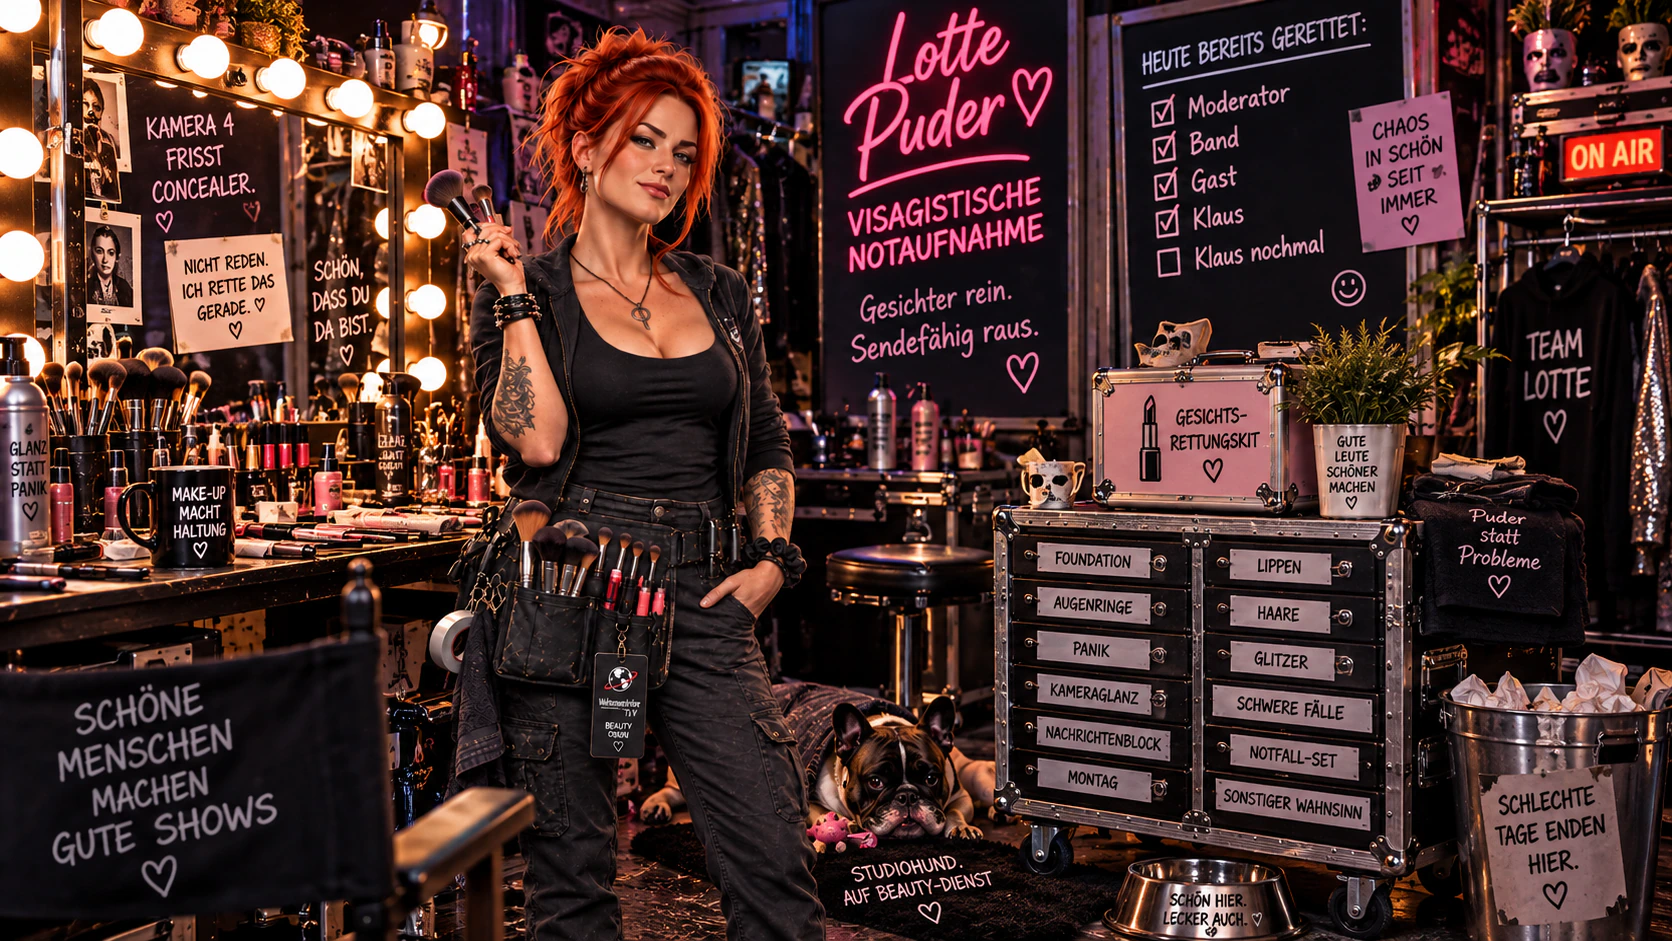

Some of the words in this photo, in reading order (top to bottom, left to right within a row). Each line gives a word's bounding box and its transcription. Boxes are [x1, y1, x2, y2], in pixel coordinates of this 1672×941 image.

[884, 8, 1010, 85] Lotte
[1142, 45, 1191, 75] HEUTE
[1198, 31, 1264, 64] BEREITS
[1272, 12, 1367, 50] GERETTET:
[1189, 85, 1290, 119] Moderator
[147, 114, 216, 140] KAMERA
[224, 112, 234, 135] 4
[844, 77, 1005, 182] Puder
[1373, 113, 1429, 140] CHAOS
[1190, 125, 1239, 155] Band
[1366, 148, 1381, 168] IN
[1389, 135, 1442, 162] SCHÖN
[166, 144, 224, 170] FRISST
[1572, 143, 1604, 170] ON
[1612, 138, 1653, 166] AIR
[152, 173, 255, 203] CONCEALER.
[1192, 166, 1237, 193] Gast
[1388, 165, 1424, 188] SEIT
[848, 177, 1043, 236] VISAGISTISCHE
[1381, 188, 1437, 214] IMMER
[1194, 205, 1244, 230] Klaus
[848, 213, 1043, 273] NOTAUFNAHME
[1196, 245, 1243, 270] Klaus
[1251, 229, 1324, 261] nochmal
[184, 257, 220, 275] NICHT
[225, 252, 268, 270] REDEN.
[314, 254, 363, 281] SCHÖN,
[183, 282, 203, 299] ICH
[208, 277, 246, 296] RETTE
[251, 274, 274, 290] DAS
[312, 289, 347, 312] DASS
[352, 285, 369, 305] DU
[198, 300, 250, 321] GERADE.
[860, 288, 957, 324] Gesichter
[966, 280, 1011, 305] rein.
[314, 319, 335, 342] DA
[339, 313, 372, 338] BIST.
[852, 322, 973, 362] Sendefähig
[984, 319, 1038, 342] raus.
[1525, 328, 1582, 360] TEAM
[1525, 366, 1591, 400] LOTTE
[1176, 407, 1247, 427] GESICHTS-
[1170, 432, 1260, 451] RETTUNGSKIT
[1337, 436, 1366, 447] GUTE
[11, 461, 46, 476] STATT
[1335, 450, 1369, 462] LEUTE
[11, 481, 47, 497] PANIK
[173, 486, 225, 501] MAKE-UP
[1330, 481, 1375, 493] MACHEN
[180, 505, 221, 520] MACHT
[1469, 509, 1526, 524] Puder
[174, 523, 226, 538] HALTUNG
[1480, 528, 1520, 545] statt
[1056, 551, 1131, 568] FOUNDATION
[1258, 559, 1301, 574] LIPPEN
[1458, 545, 1541, 569] Probleme
[1054, 596, 1132, 614] AUGENRINGE
[1258, 606, 1299, 622] HAARE
[1074, 641, 1109, 657] PANIK
[1255, 651, 1308, 669] GLITZER
[1051, 683, 1138, 704] KAMERAGLANZ
[75, 683, 203, 735] SCHÖNE
[1237, 696, 1298, 715] SCHWERE
[1305, 700, 1344, 720] FÄLLE
[58, 719, 232, 782] MENSCHEN
[1045, 726, 1161, 752] NACHRICHTENBLOCK
[1250, 746, 1337, 768] NOTFALL-SET
[92, 766, 209, 816] MACHEN
[1068, 770, 1118, 790] MONTAG
[1224, 789, 1291, 810] SONSTIGER
[1296, 798, 1362, 819] WAHNSINN
[1499, 785, 1595, 815] SCHLECHTE
[53, 821, 135, 866] GUTE
[154, 793, 277, 845] SHOWS
[1495, 823, 1539, 846] TAGE
[1546, 814, 1605, 842] ENDEN
[851, 856, 963, 883] STUDIOHUND.
[1528, 850, 1578, 874] HIER.
[844, 887, 870, 906] AUF
[877, 870, 991, 901] BEAUTY-DIENST
[1216, 893, 1247, 907] HIER.
[1163, 911, 1208, 926] LECKER
[1212, 911, 1248, 926] AUCH.
